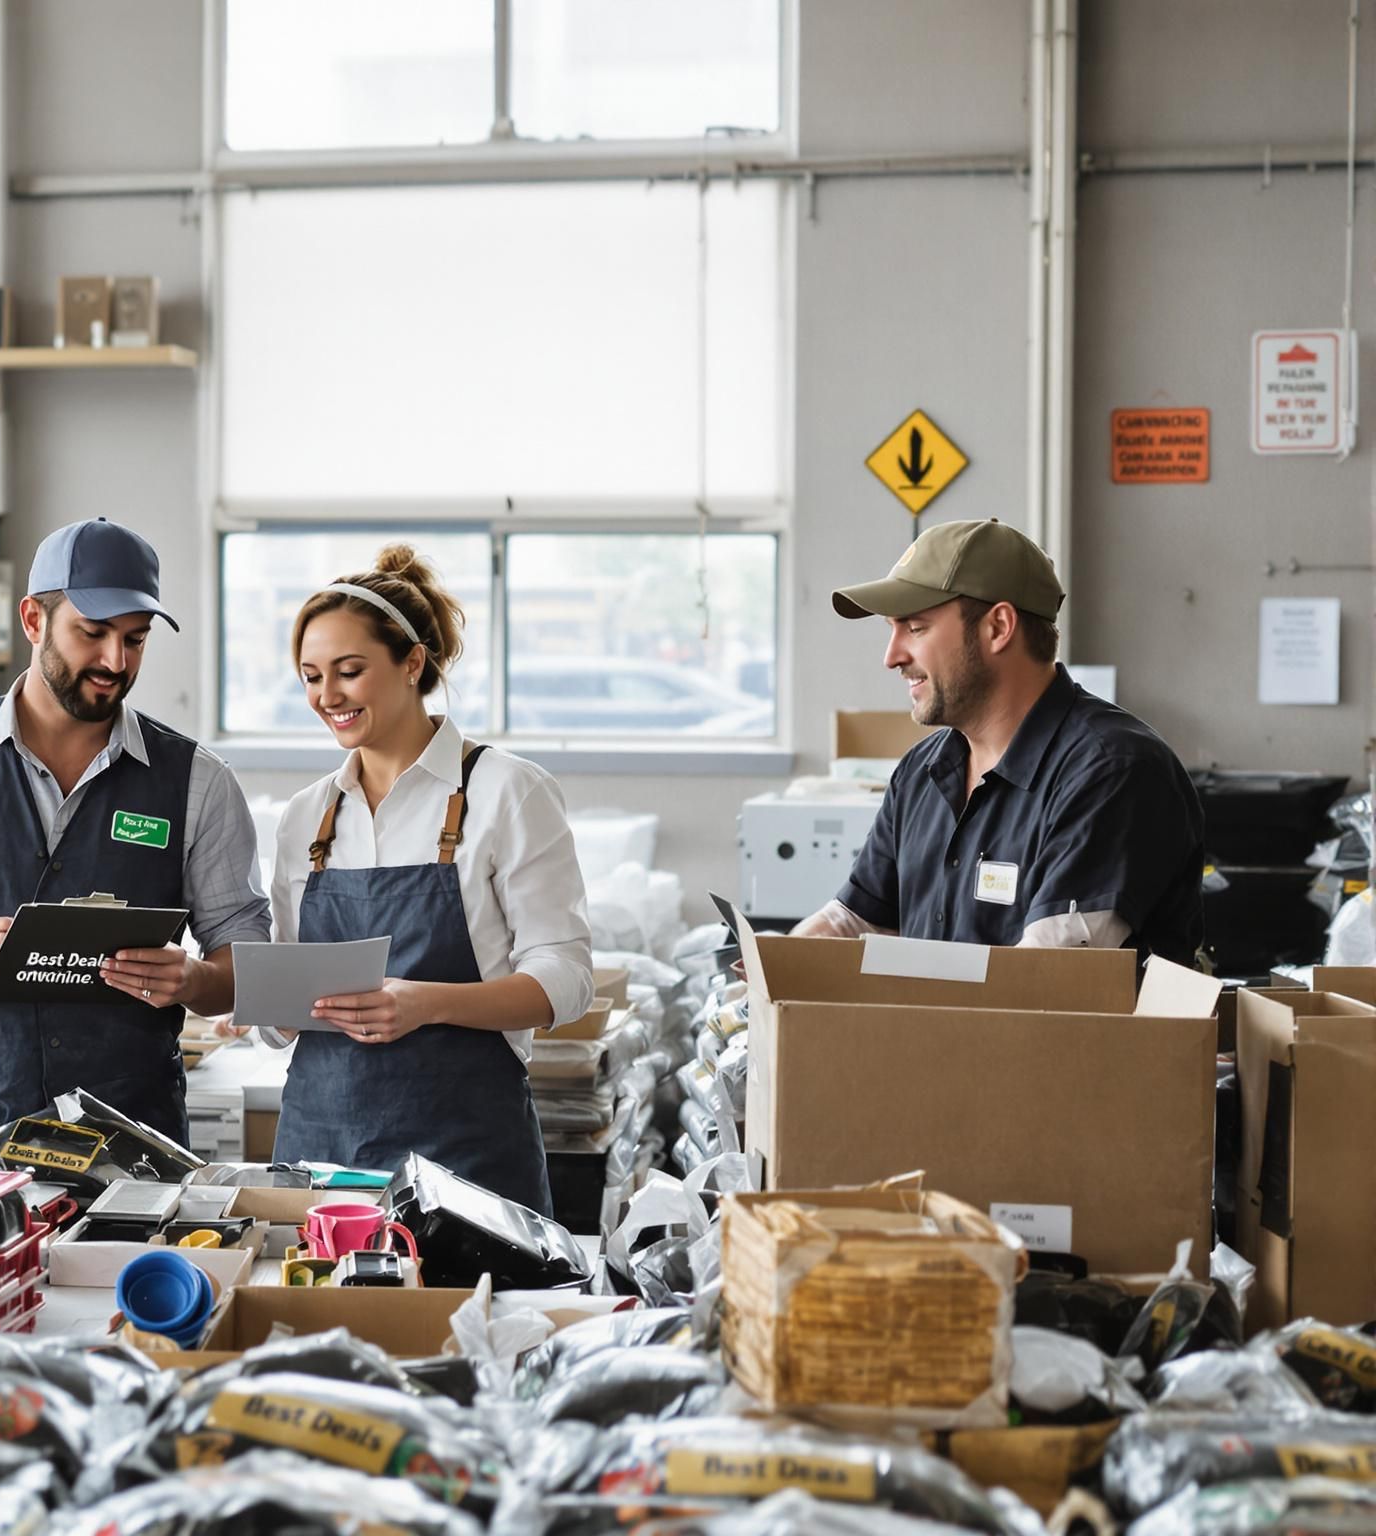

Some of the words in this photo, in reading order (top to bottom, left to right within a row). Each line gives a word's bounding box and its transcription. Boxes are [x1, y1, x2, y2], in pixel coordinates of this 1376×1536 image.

[26, 952, 64, 967] Best
[243, 1395, 305, 1427] Best
[310, 1408, 383, 1452] Deals
[703, 1454, 767, 1479] Best
